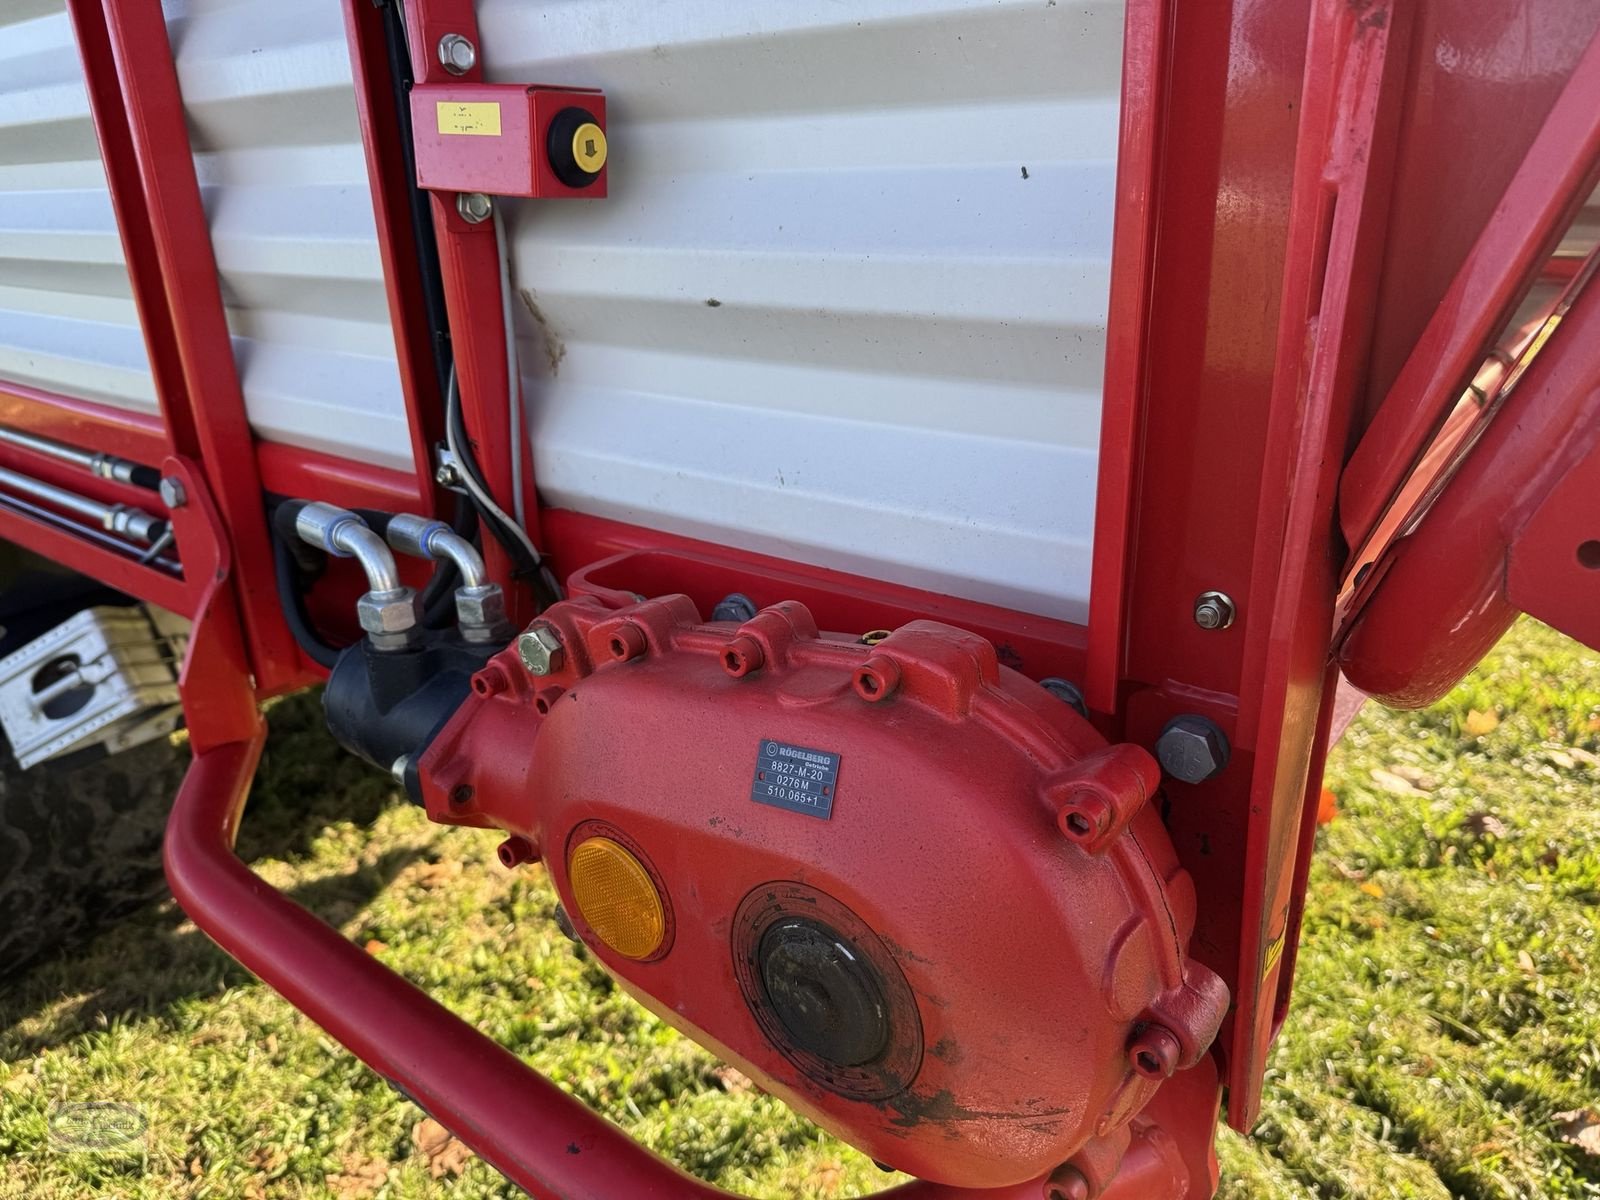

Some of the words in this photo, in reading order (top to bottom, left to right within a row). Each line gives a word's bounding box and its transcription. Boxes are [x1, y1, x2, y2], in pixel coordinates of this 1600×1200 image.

[779, 747, 831, 765] RÖGELBERG
[771, 761, 823, 781] 8827-M-20
[767, 785, 818, 806] 510.065+1
